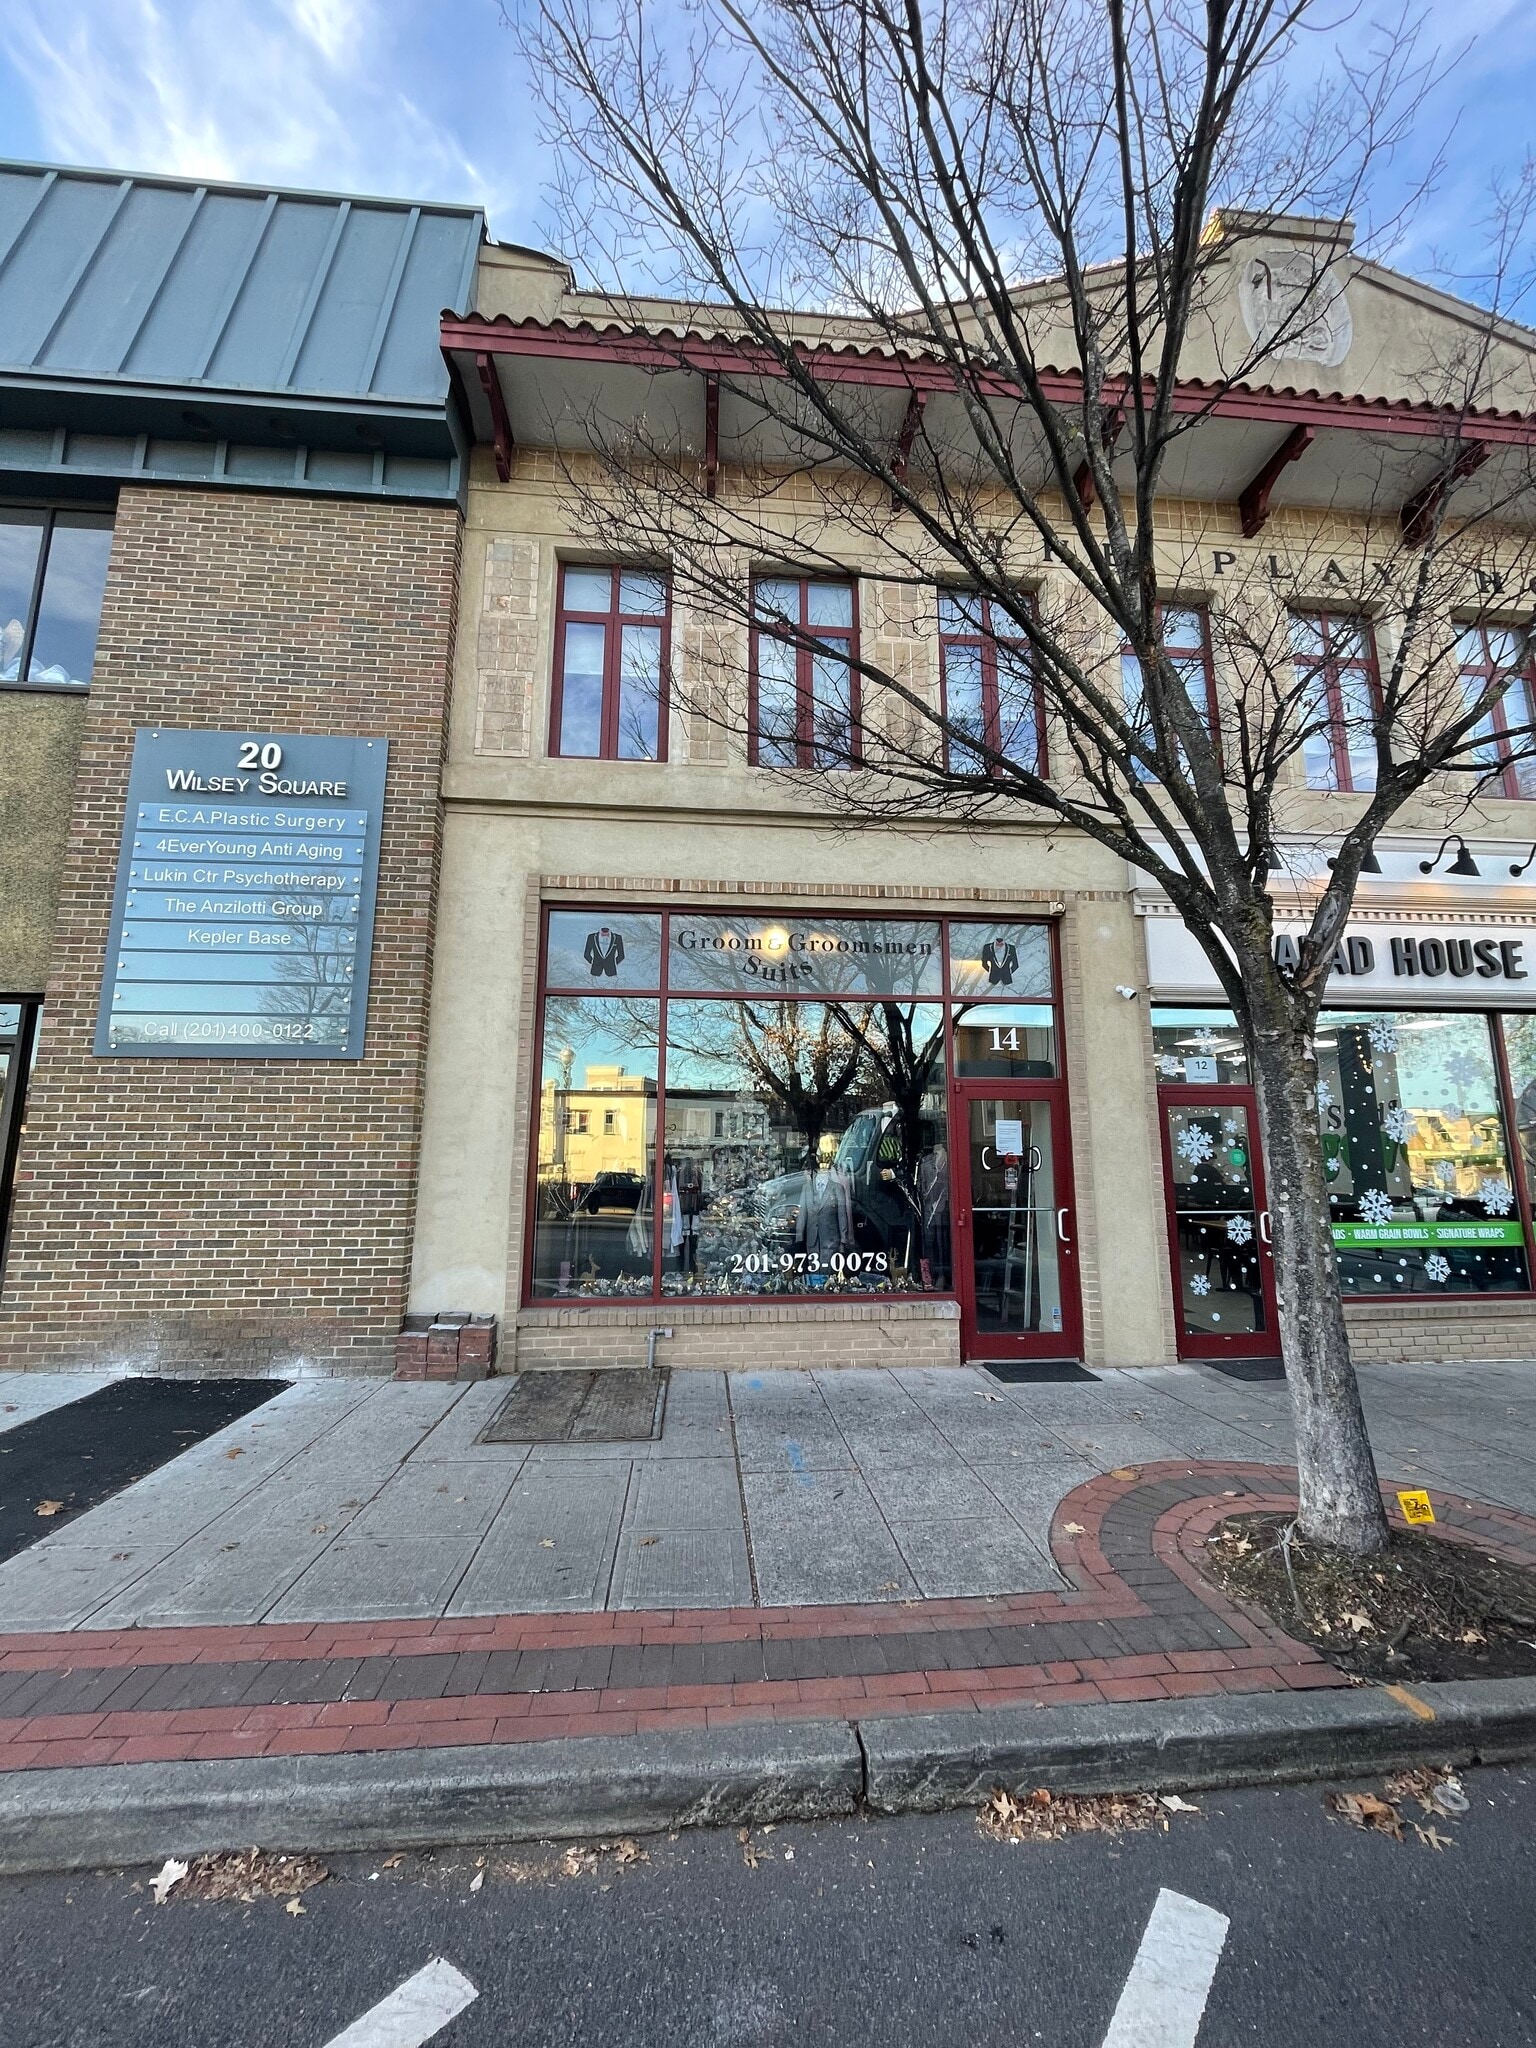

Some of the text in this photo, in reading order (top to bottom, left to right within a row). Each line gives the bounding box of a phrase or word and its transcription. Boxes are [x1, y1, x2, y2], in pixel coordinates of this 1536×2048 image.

[237, 741, 282, 770] 20
[166, 769, 346, 796] WILSEY SQUARE
[274, 813, 346, 831] Surgery
[156, 839, 343, 860] 4EverYoung Anti Aging
[143, 868, 346, 890] Lukin Ctr Psychotherapy
[164, 898, 323, 919] The Anzilotti Group
[187, 929, 291, 946] Kepler Base
[677, 930, 932, 955] Groom & Groomsmen
[1390, 936, 1528, 979] HOUSE
[742, 955, 813, 982] Suits
[144, 1022, 314, 1040] Call (201)400-0122
[988, 1027, 1020, 1051] 14
[1195, 1060, 1208, 1070] 12
[1353, 1228, 1378, 1240] WARM
[1378, 1228, 1402, 1239] GRAIN
[1403, 1228, 1429, 1239] BOWLS
[1436, 1228, 1477, 1239] SIGNATURE
[1478, 1227, 1505, 1239] WRAPS
[731, 1252, 888, 1273] 201-973-0078
